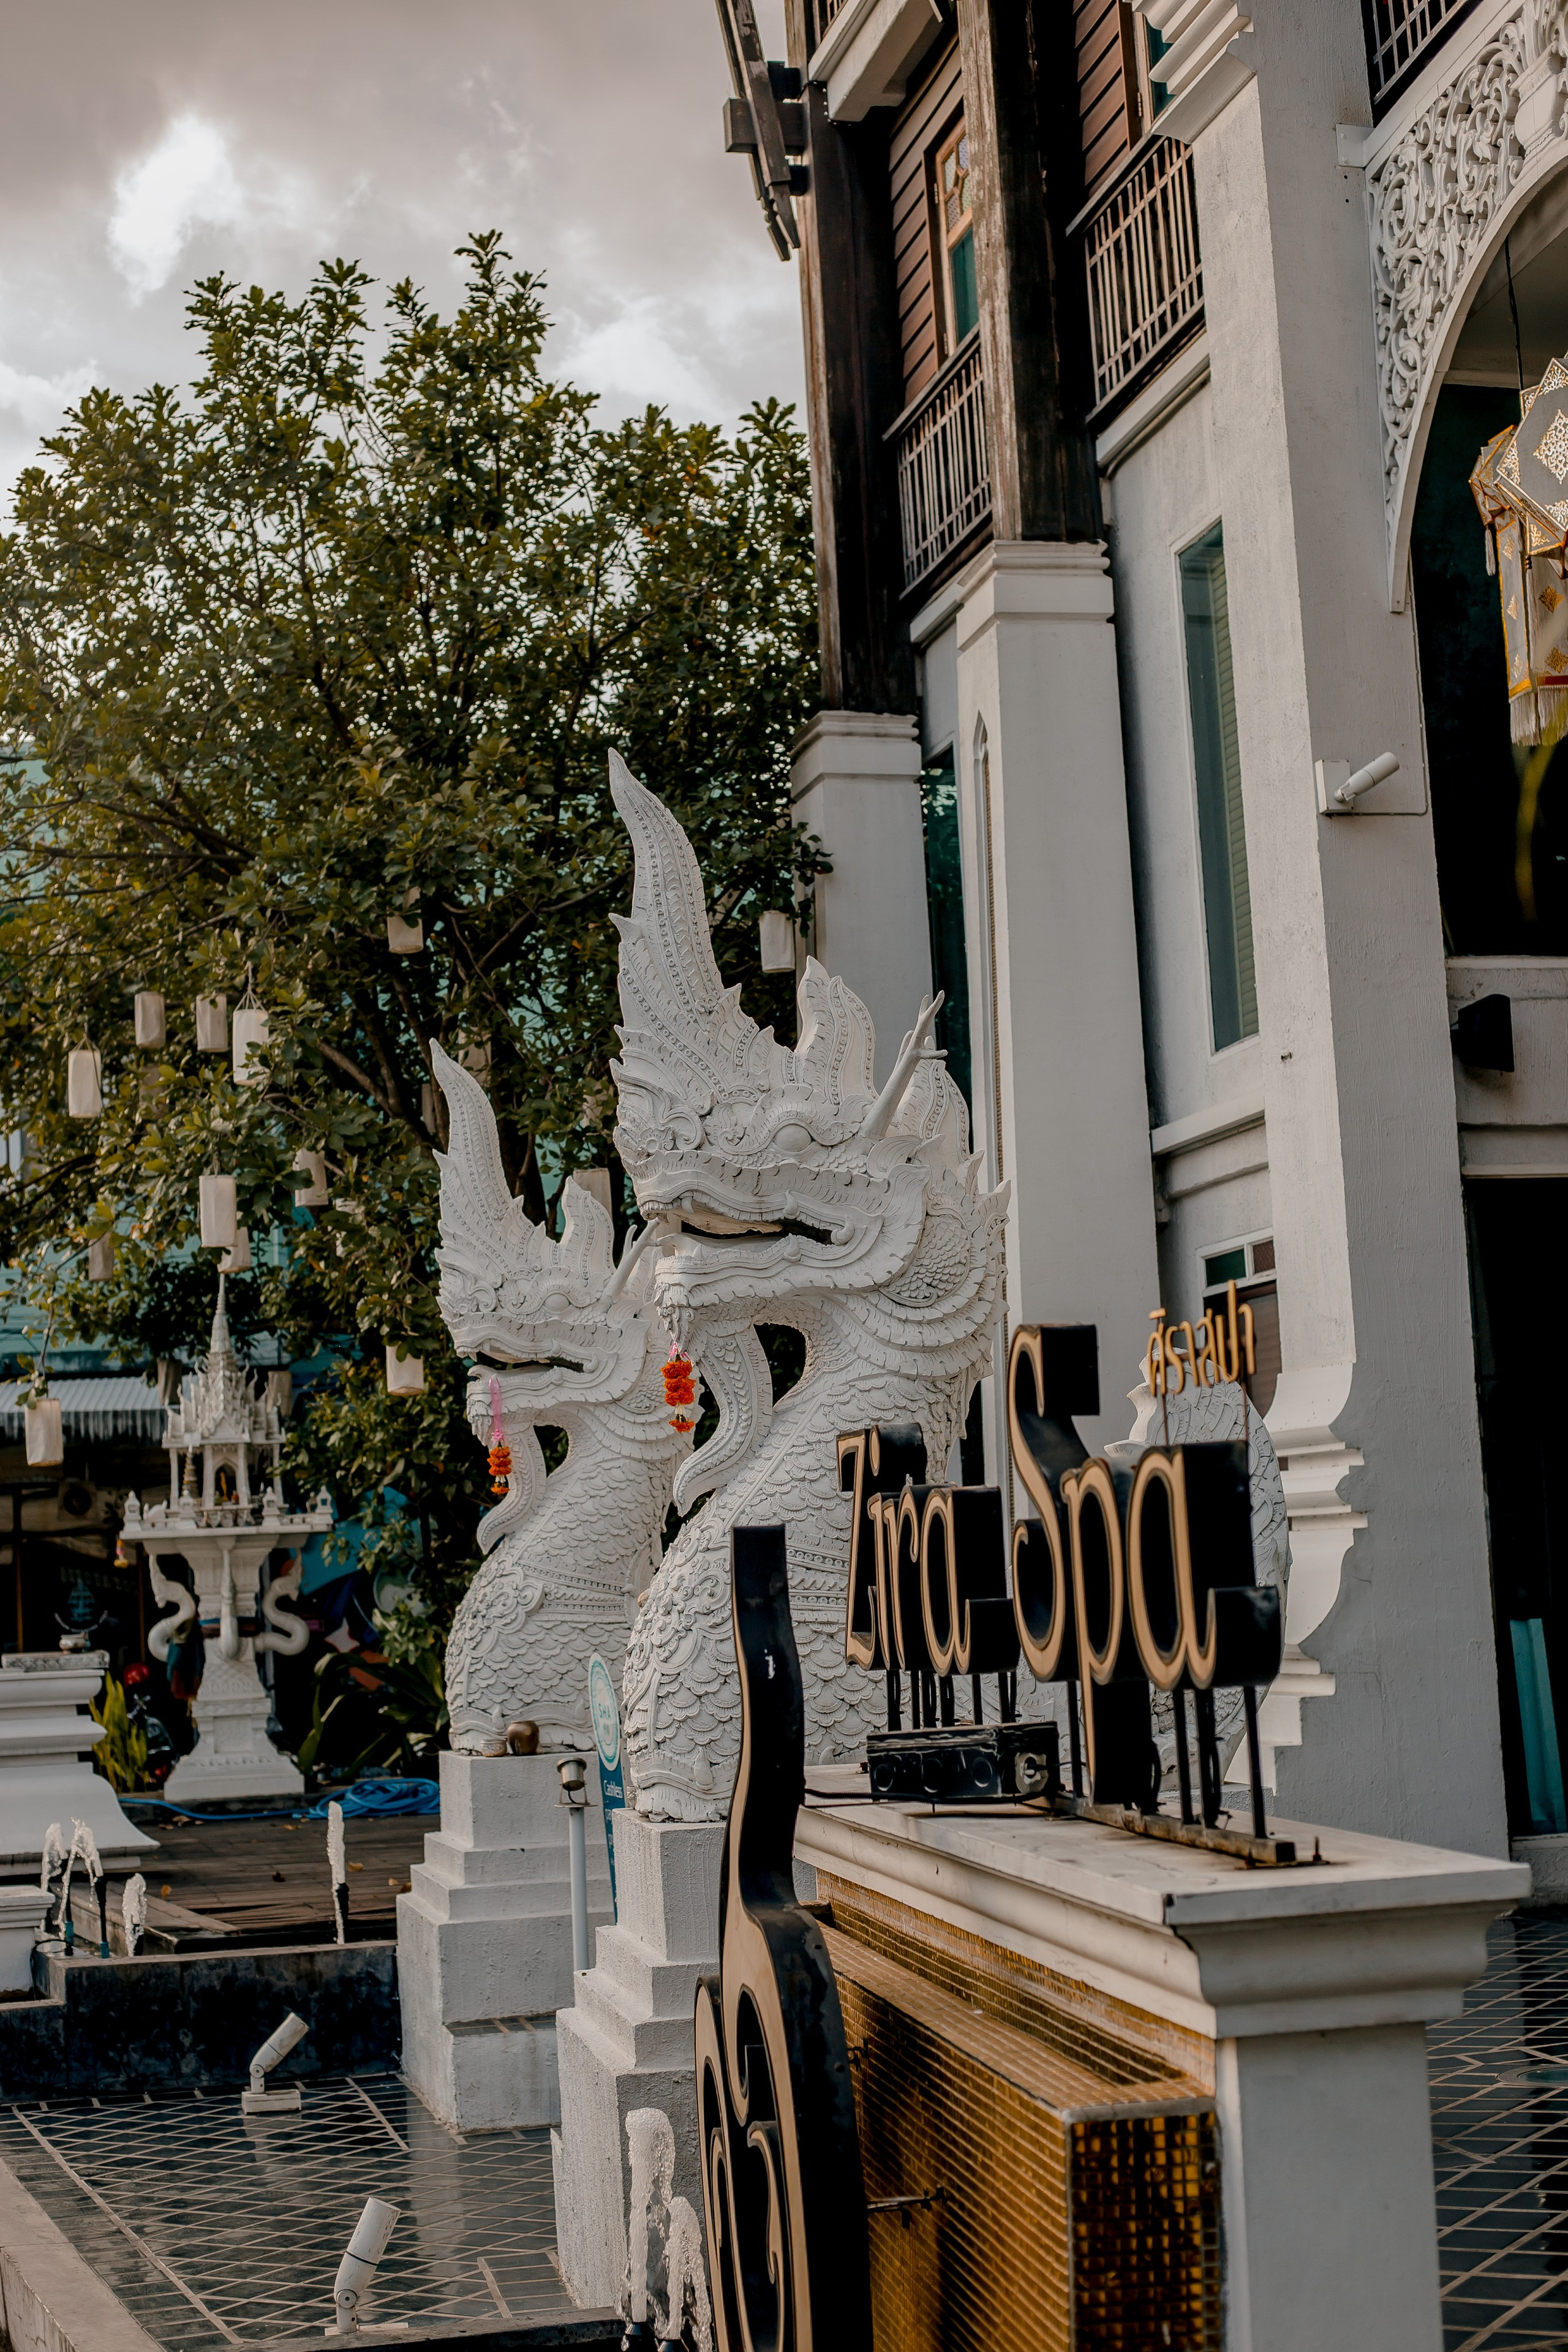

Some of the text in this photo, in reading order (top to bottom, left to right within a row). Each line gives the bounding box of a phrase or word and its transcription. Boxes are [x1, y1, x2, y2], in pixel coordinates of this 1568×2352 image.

[836, 1324, 1218, 1804] Zira Spa
[598, 1703, 611, 1719] SHA
[603, 1779, 623, 1799] Cashless
